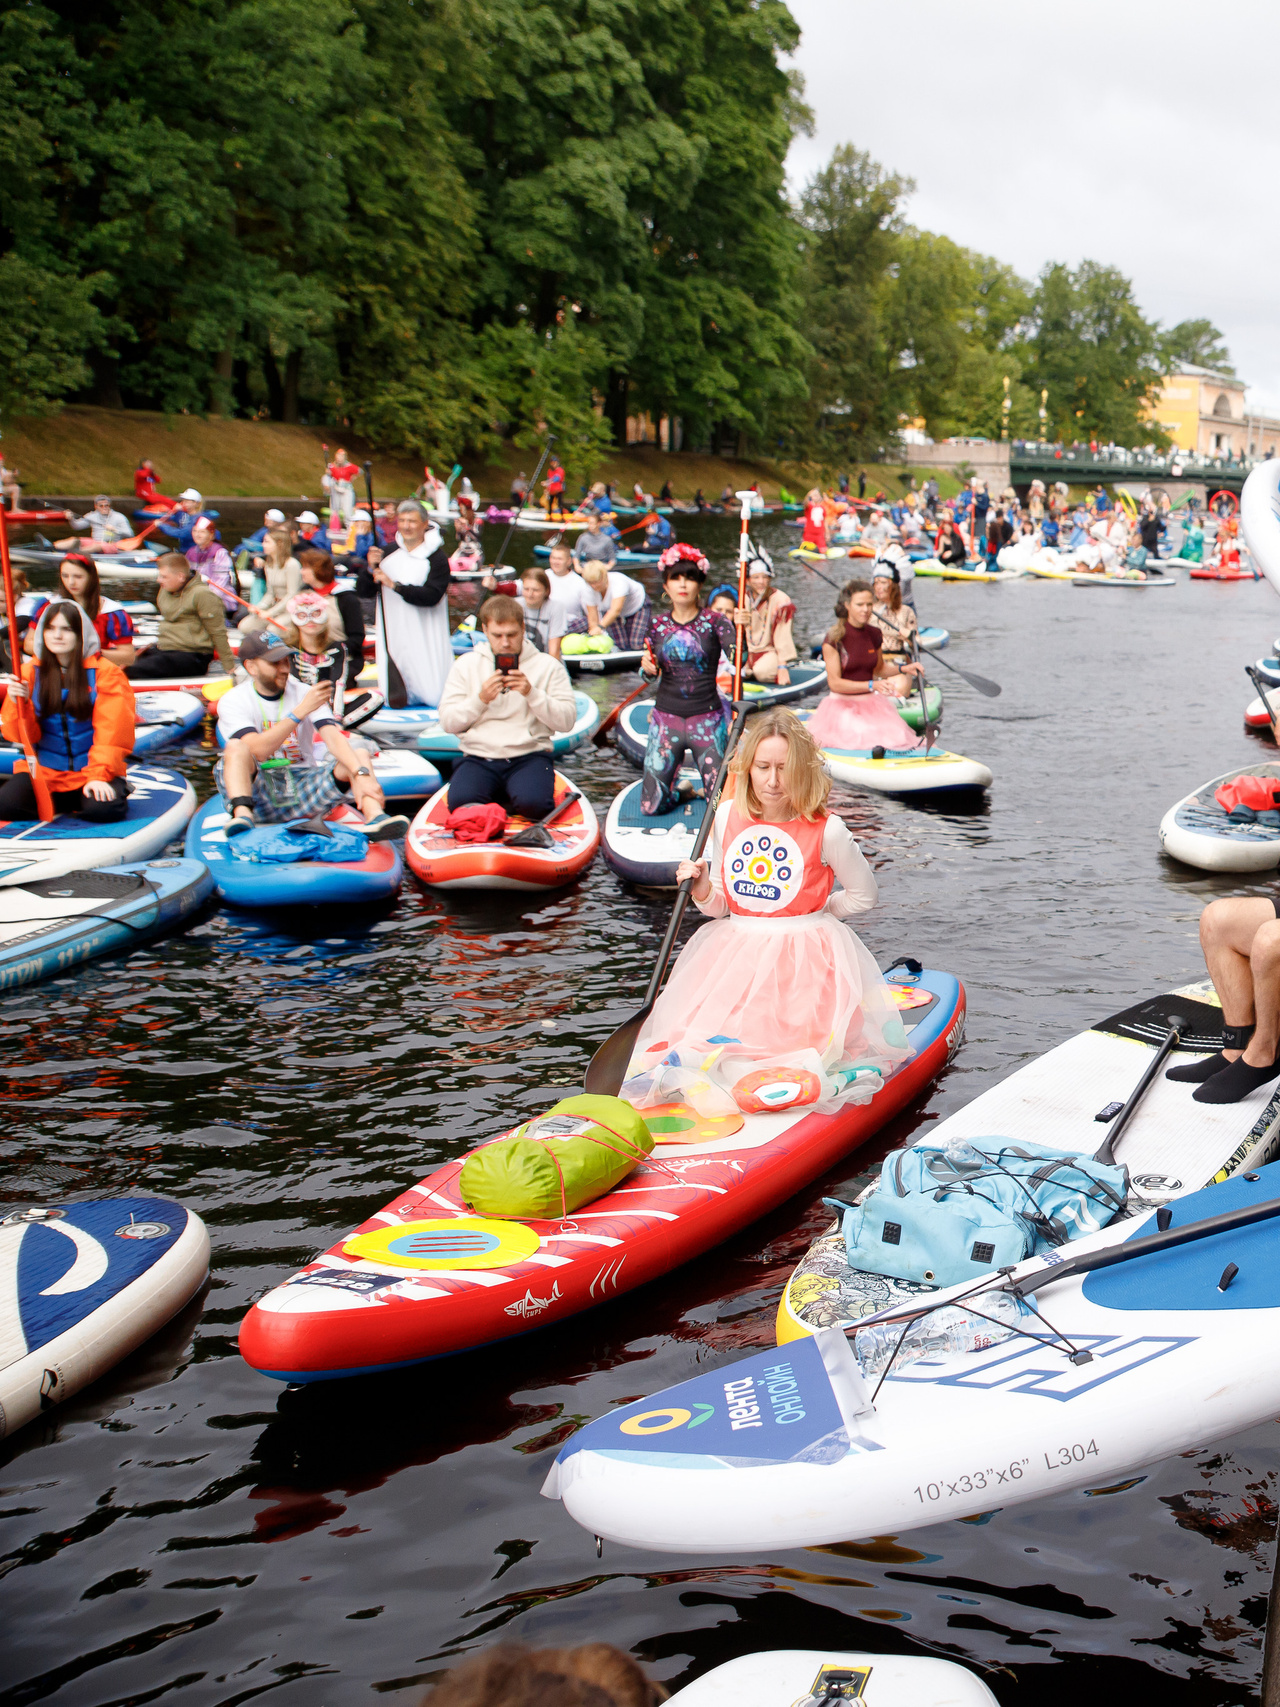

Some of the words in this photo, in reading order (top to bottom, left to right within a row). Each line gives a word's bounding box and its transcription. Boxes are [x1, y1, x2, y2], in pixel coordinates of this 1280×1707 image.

[737, 882, 776, 898] КИРОВ
[723, 1376, 763, 1431] лента
[757, 1362, 807, 1425] онлайн
[1044, 1438, 1100, 1470] L304
